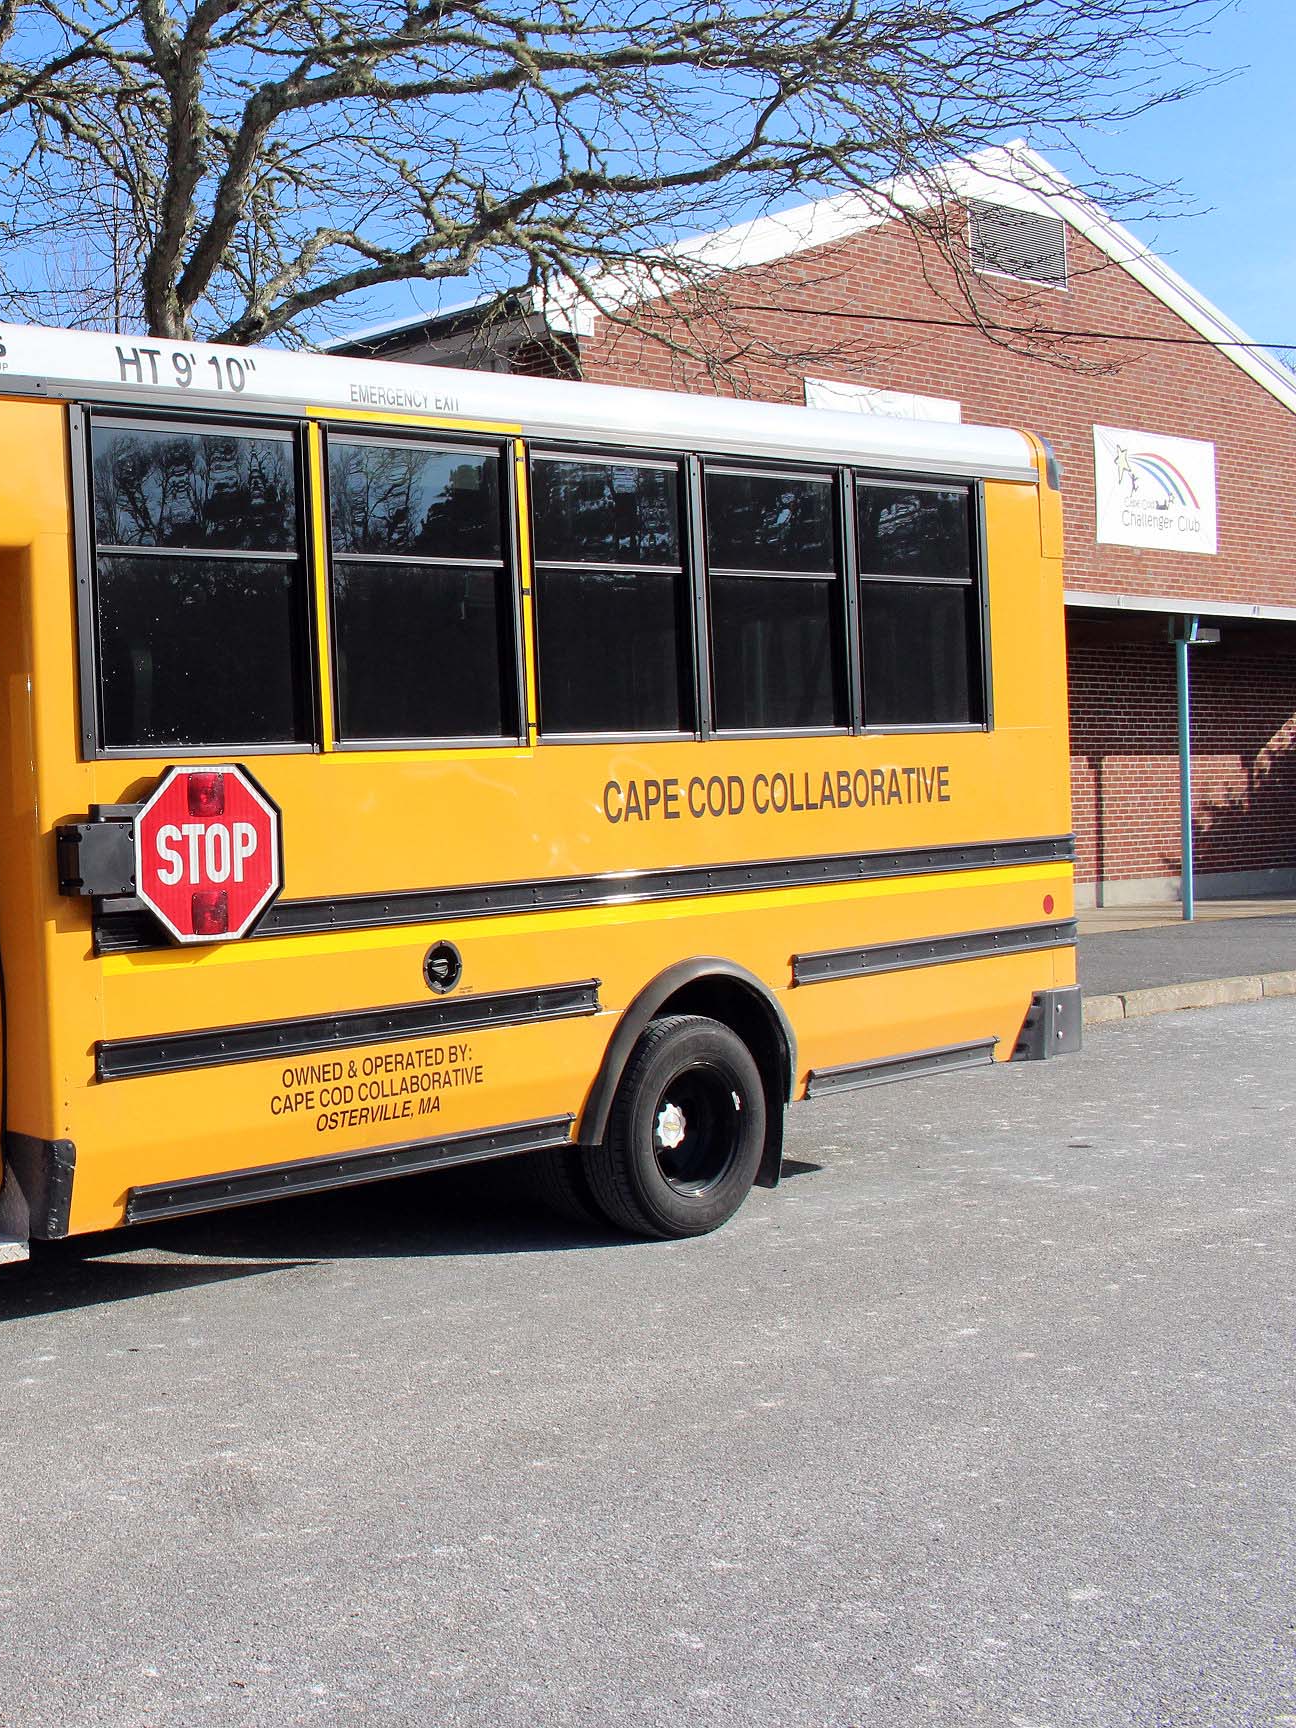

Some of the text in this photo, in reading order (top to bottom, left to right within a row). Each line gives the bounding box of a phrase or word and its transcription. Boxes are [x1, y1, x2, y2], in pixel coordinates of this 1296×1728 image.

[115, 346, 256, 392] HT 9' 10"
[350, 384, 459, 411] EMERGENCY EXIT
[1122, 510, 1201, 532] Challenger Club
[603, 766, 950, 823] CAPE COD COLLABORATIVE
[156, 822, 257, 885] STOP
[282, 1044, 472, 1088] OWNED & OPERATED BY:
[271, 1066, 483, 1115] CAPE COD COLLABORATIVE
[316, 1096, 440, 1131] OSTERVILLE, MA
